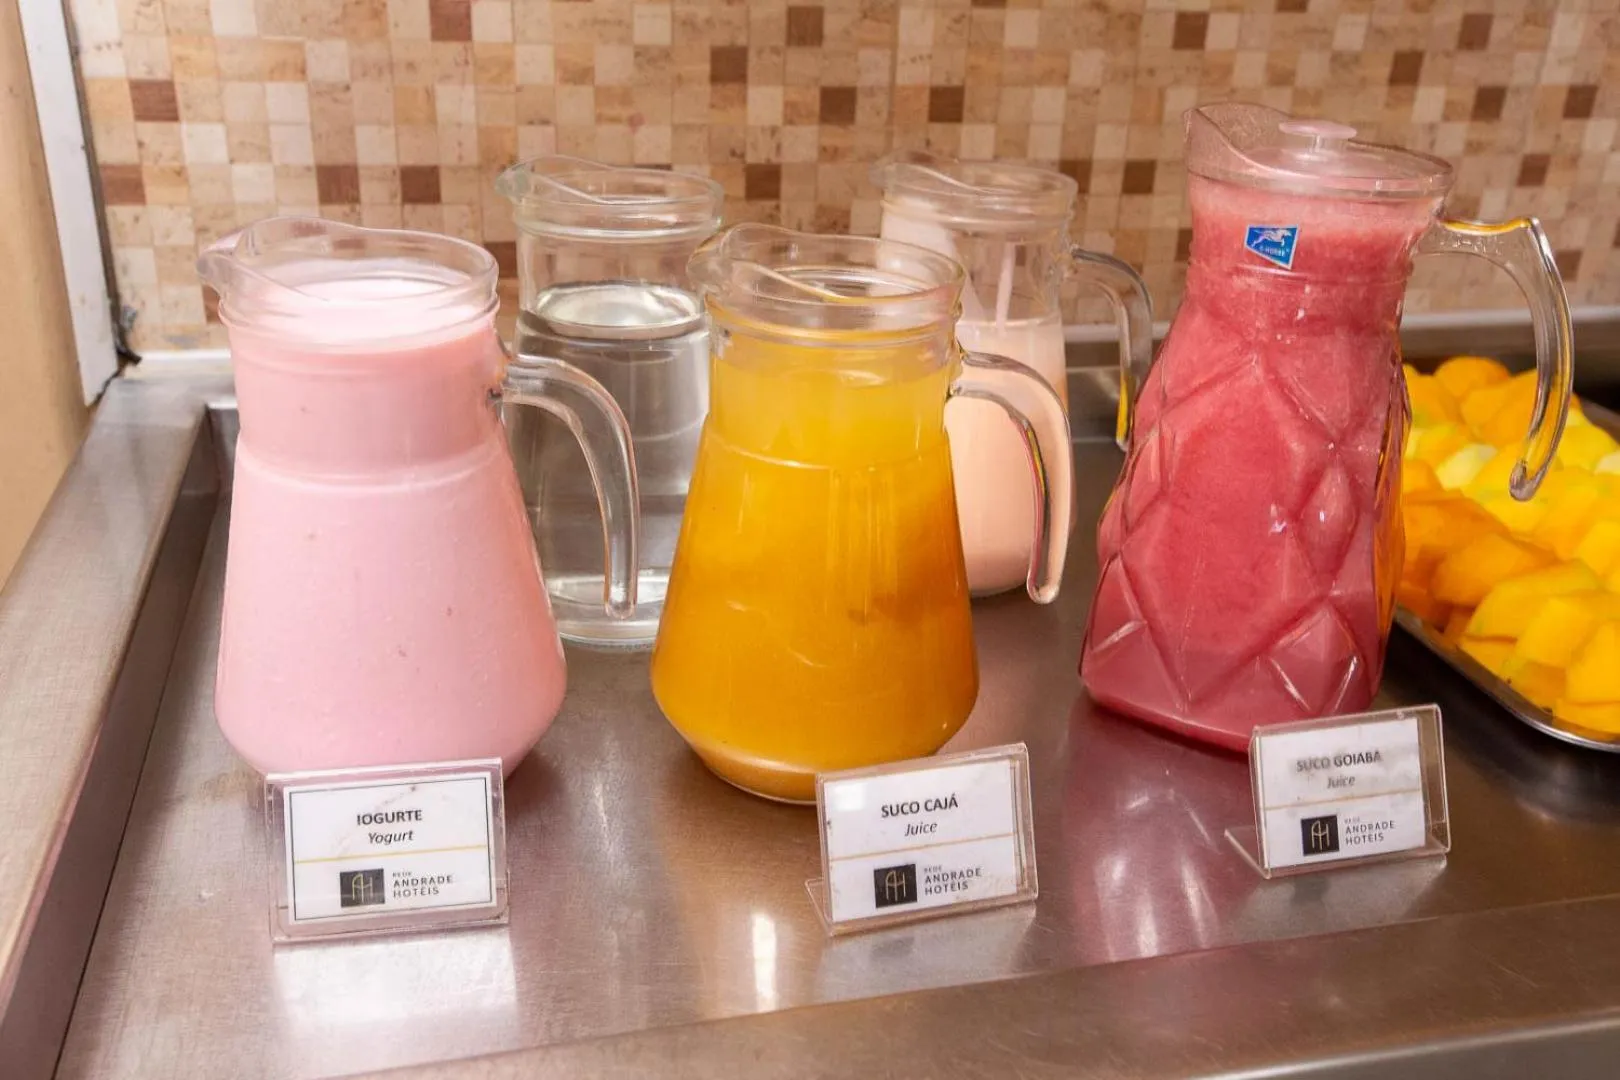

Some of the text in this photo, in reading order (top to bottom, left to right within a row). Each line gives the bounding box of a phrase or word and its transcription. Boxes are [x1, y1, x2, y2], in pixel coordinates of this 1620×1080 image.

[1296, 751, 1382, 773] SUCO GOIABA
[1327, 775, 1355, 789] Juice
[881, 793, 958, 818] SUCO CAJÁ
[357, 809, 422, 825] IOGURTE
[905, 821, 938, 837] Juice
[1345, 820, 1395, 834] ANDRADE
[368, 830, 414, 845] Yogurt
[393, 874, 453, 887] ANDRADE
[925, 868, 982, 883] ANDRADE
